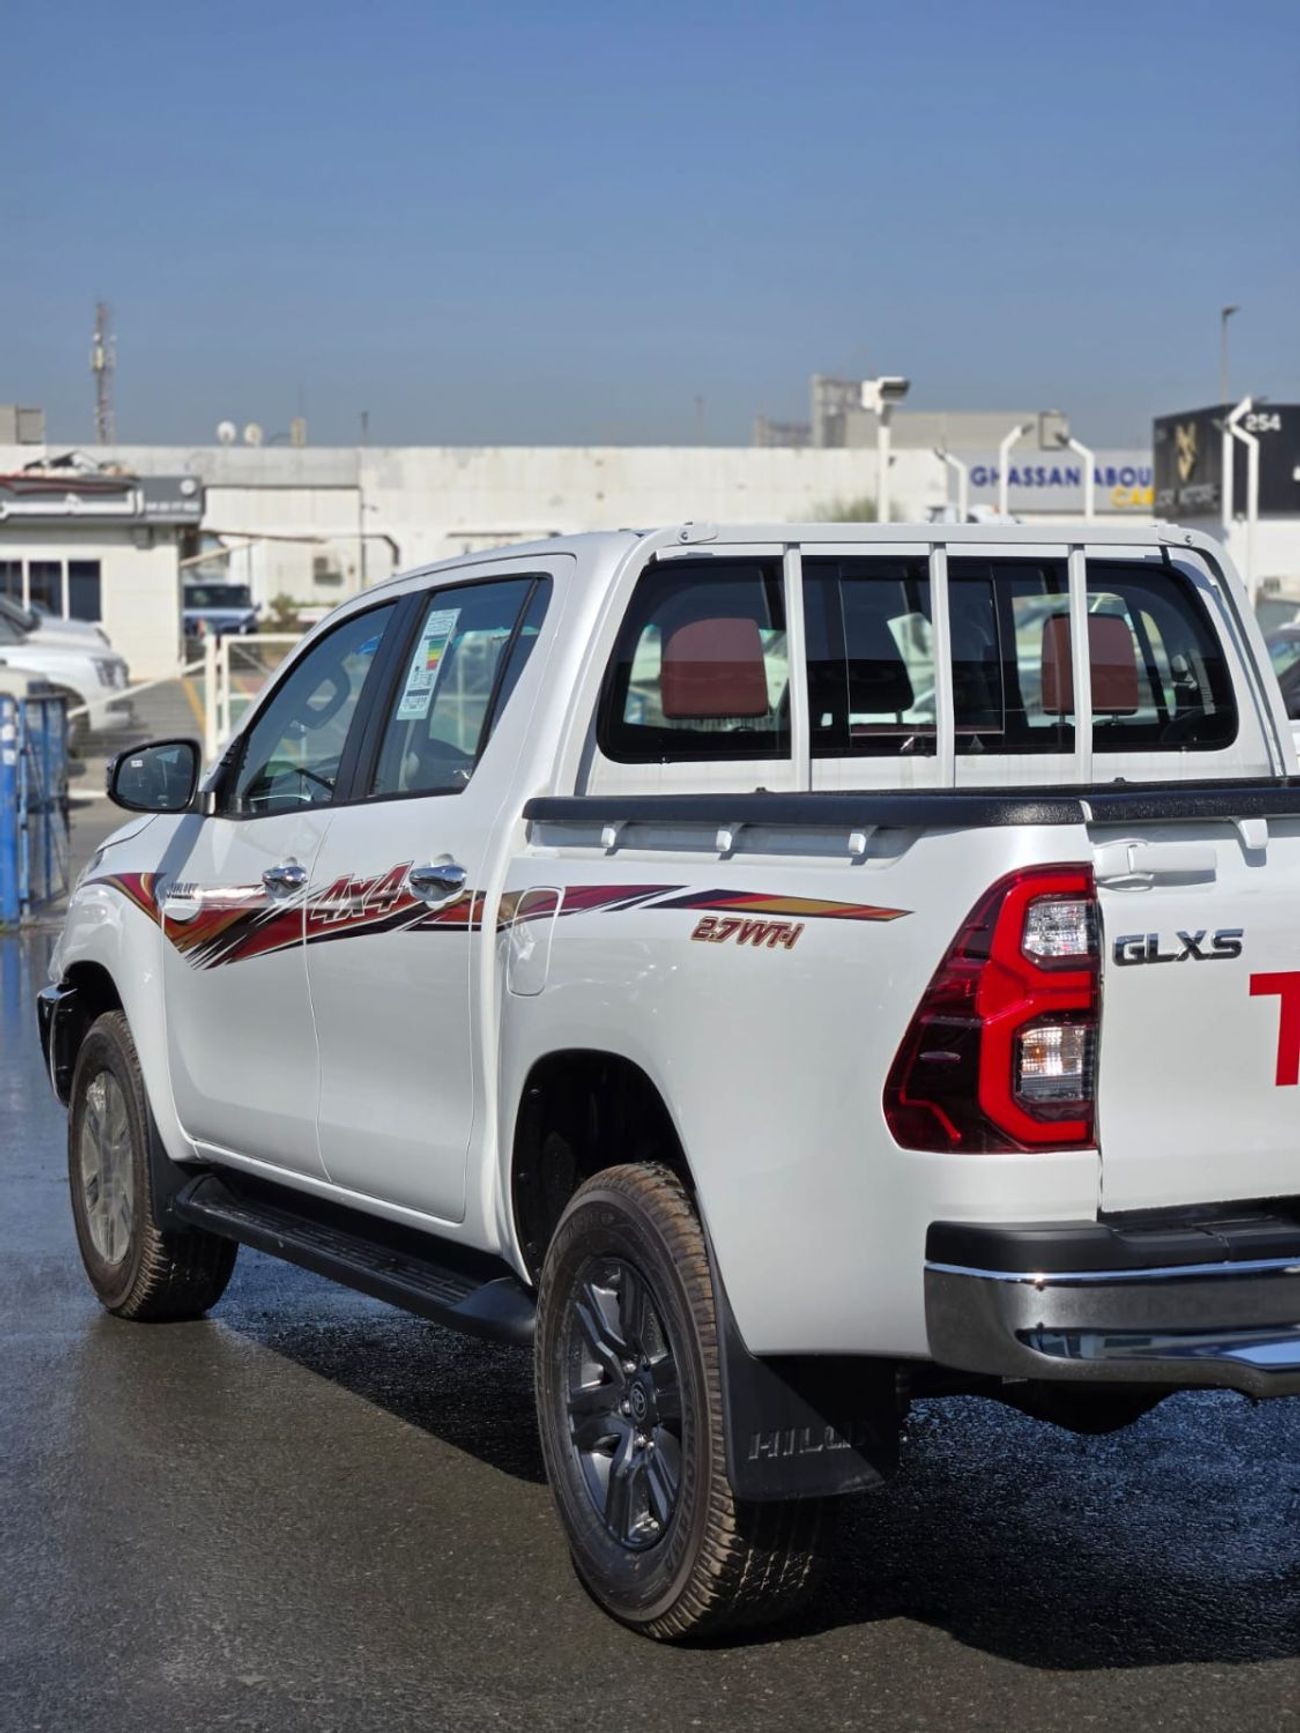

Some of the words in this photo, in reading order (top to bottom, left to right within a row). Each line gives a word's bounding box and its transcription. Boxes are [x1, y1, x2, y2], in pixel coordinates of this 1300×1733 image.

[1245, 413, 1281, 431] 254
[969, 465, 1080, 488] GHASSAN
[1112, 927, 1244, 967] GLXS
[747, 1424, 862, 1460] HILU
